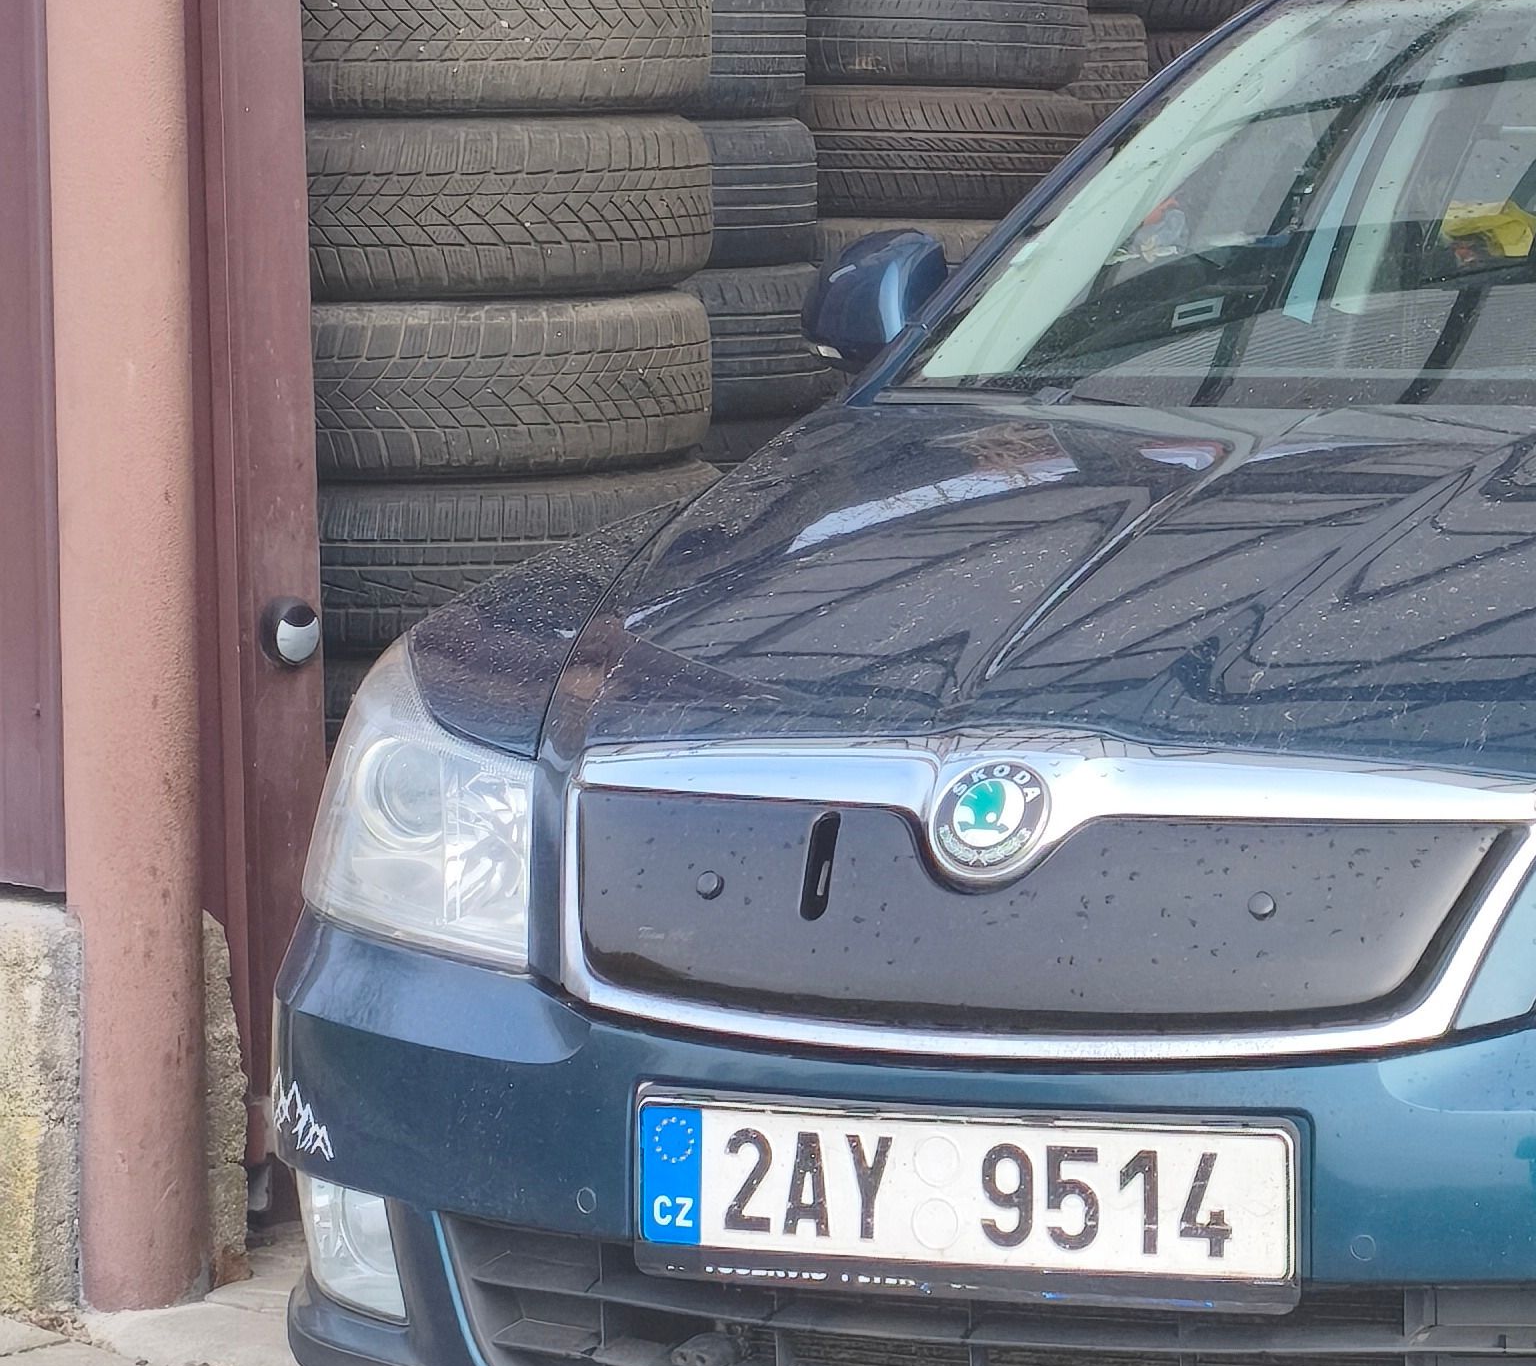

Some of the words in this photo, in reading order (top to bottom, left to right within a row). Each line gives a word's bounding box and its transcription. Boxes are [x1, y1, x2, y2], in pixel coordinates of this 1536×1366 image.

[653, 1194, 694, 1228] CZ
[722, 1126, 893, 1241] 2AY
[980, 1141, 1234, 1258] 9514
